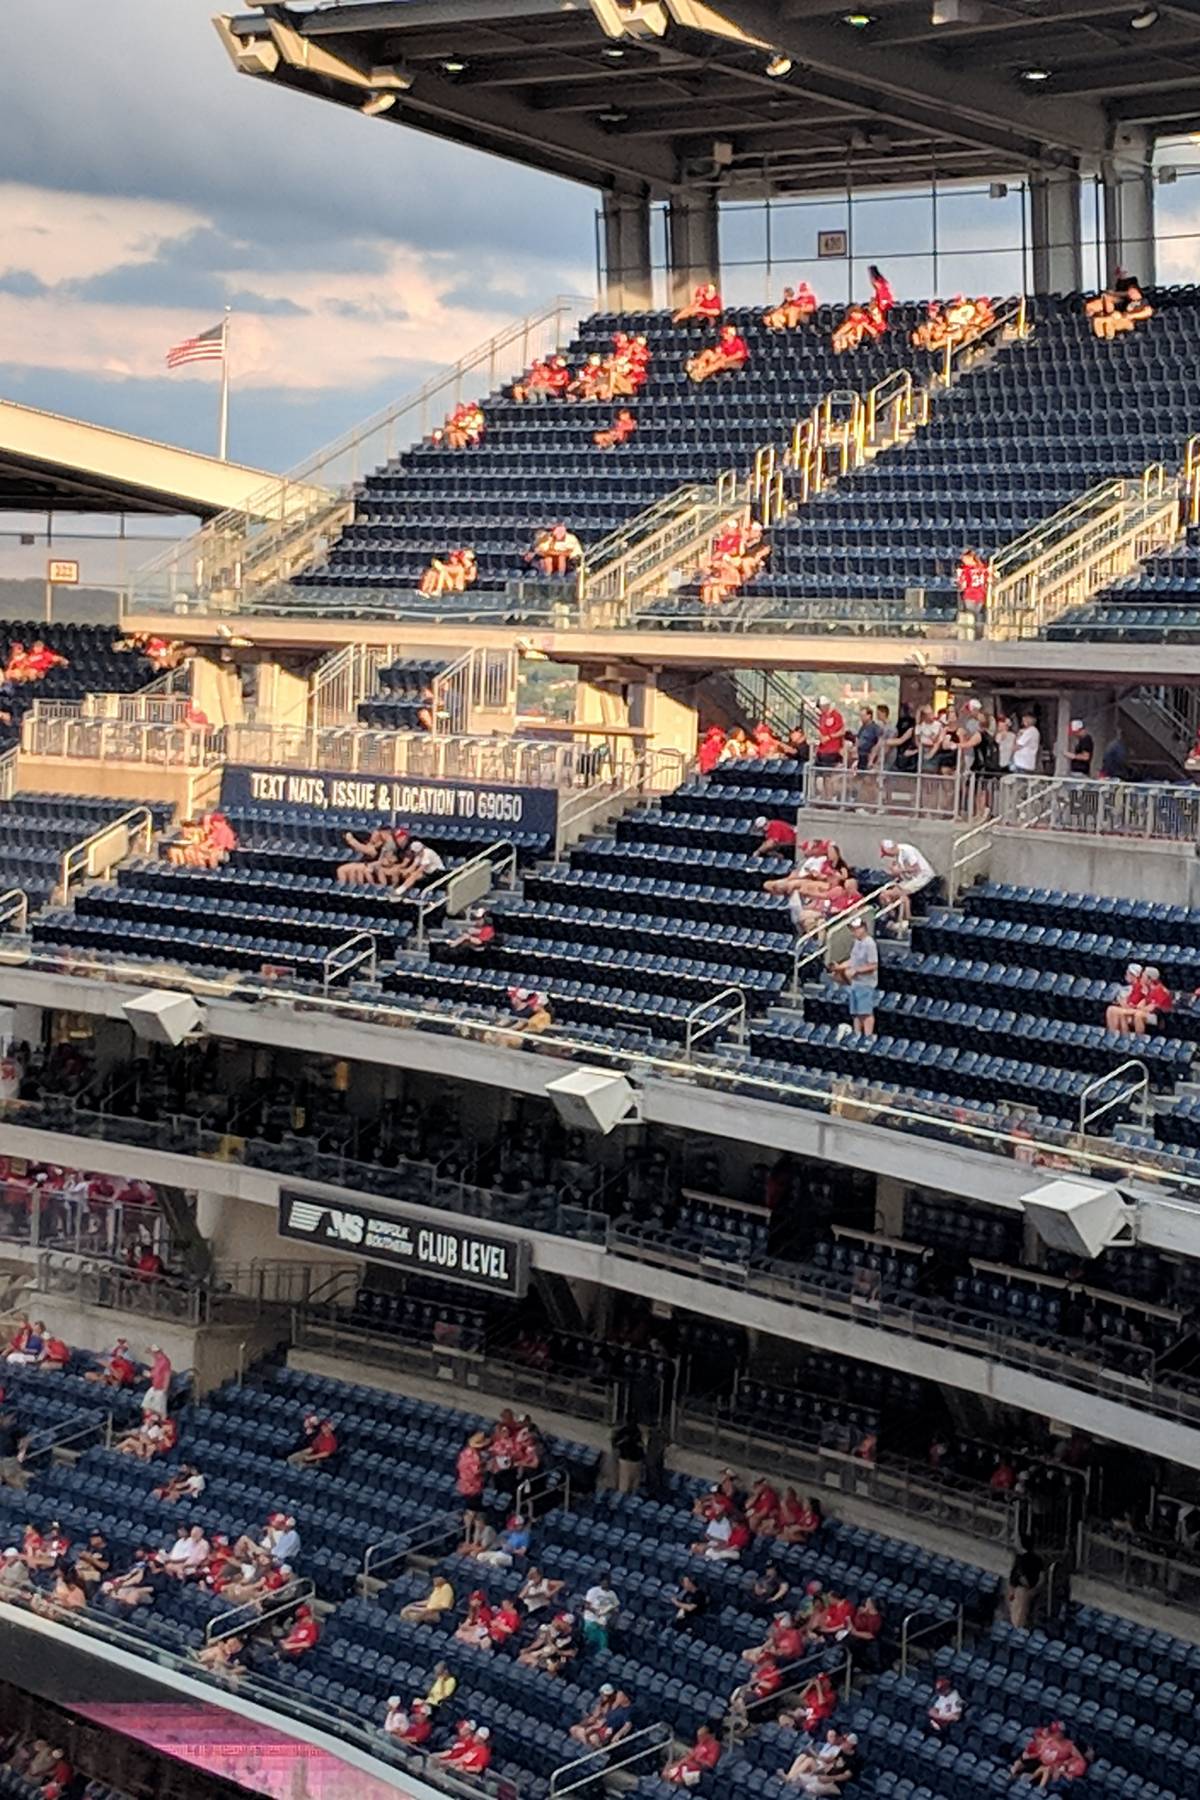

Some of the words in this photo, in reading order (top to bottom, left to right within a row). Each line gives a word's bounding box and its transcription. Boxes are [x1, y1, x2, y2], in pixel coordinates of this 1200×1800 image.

[251, 772, 287, 801] TEXT
[288, 776, 328, 810] NATS,
[332, 780, 376, 810] ISSUE
[377, 784, 392, 811] &
[395, 784, 455, 816] LOCATION
[457, 790, 475, 819] TO
[477, 792, 523, 822] 69050
[418, 1229, 458, 1268] CLUB
[461, 1239, 509, 1280] LEVEL
